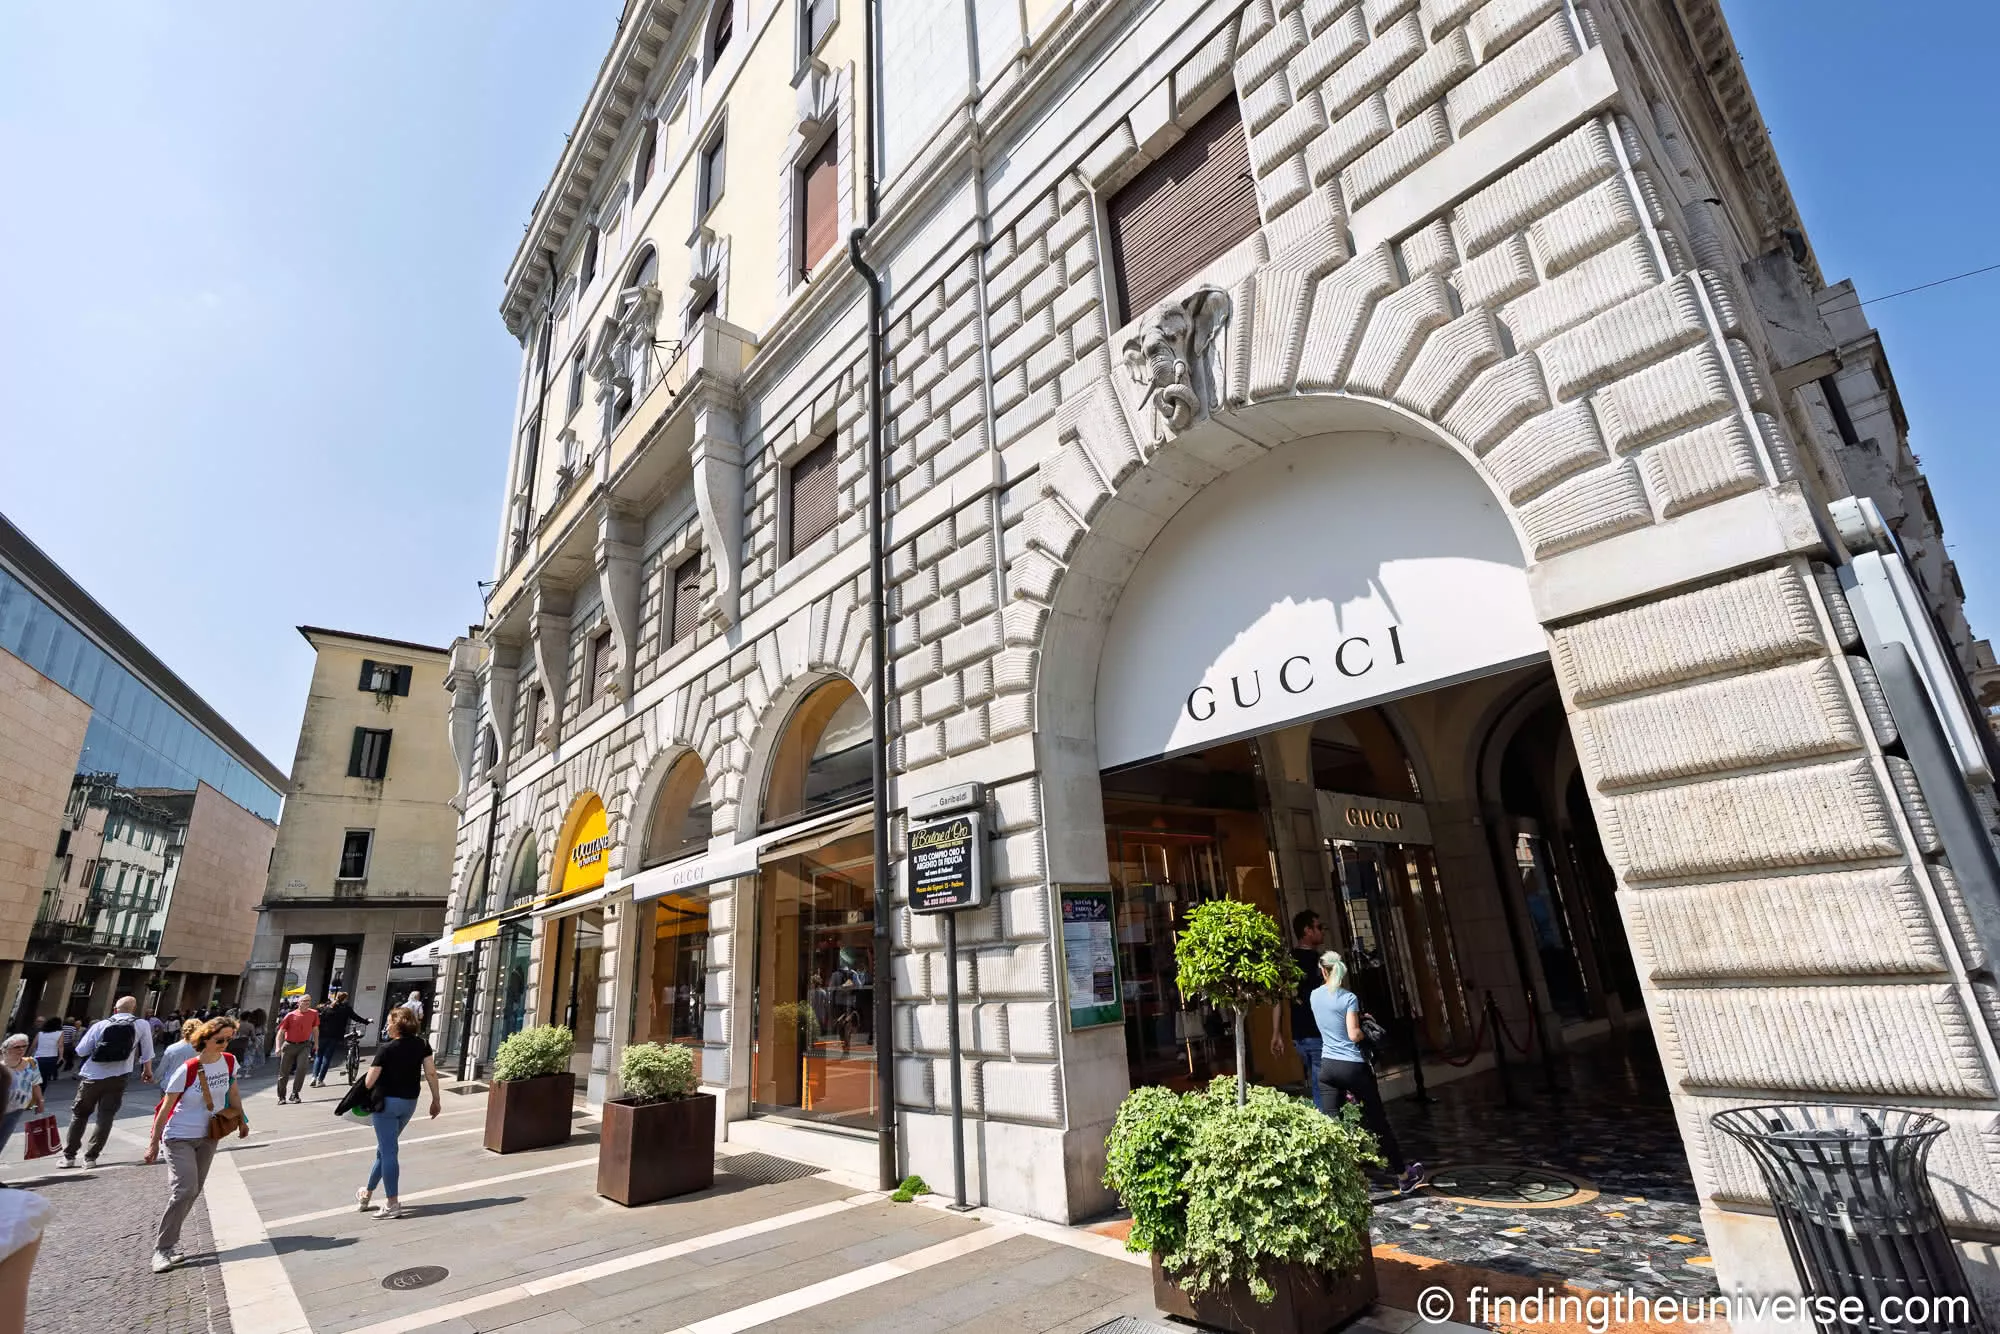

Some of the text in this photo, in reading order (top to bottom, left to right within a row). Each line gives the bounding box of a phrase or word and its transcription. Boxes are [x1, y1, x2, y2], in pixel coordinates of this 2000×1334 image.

[1187, 625, 1405, 721] GUCCI
[1345, 807, 1402, 830] GUCCI
[928, 850, 948, 860] COMPRO
[949, 848, 960, 856] ORO
[944, 855, 963, 865] FIDUCIA
[673, 866, 703, 885] GUCCI
